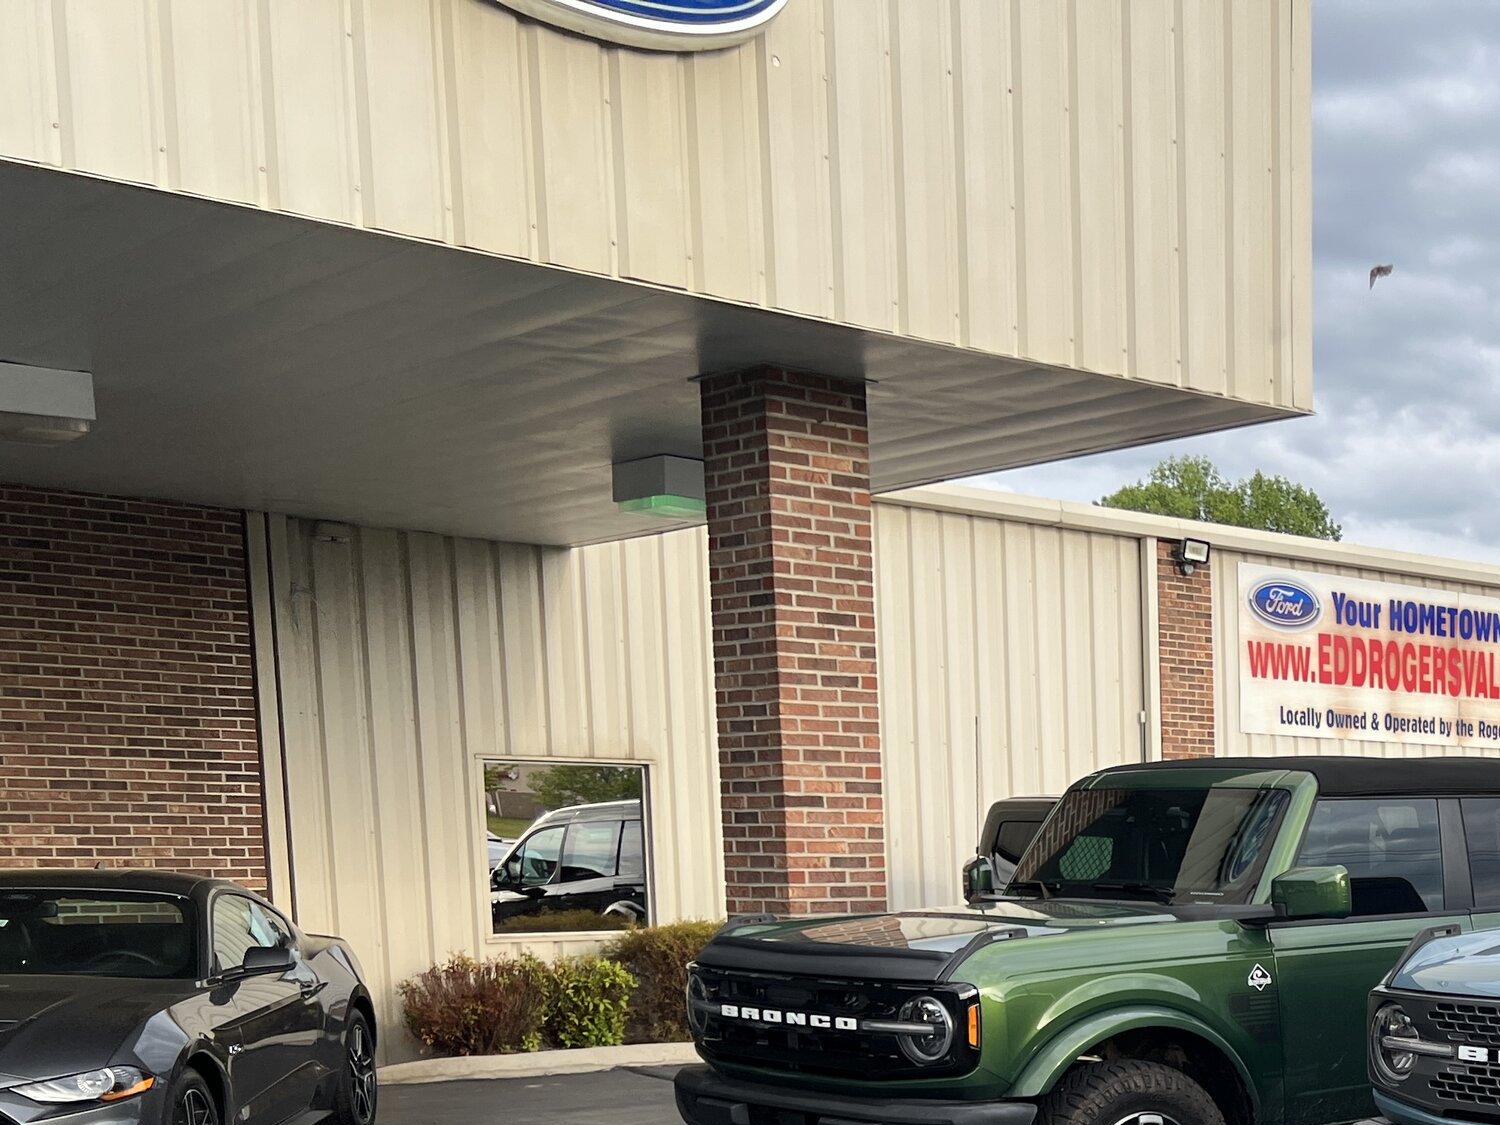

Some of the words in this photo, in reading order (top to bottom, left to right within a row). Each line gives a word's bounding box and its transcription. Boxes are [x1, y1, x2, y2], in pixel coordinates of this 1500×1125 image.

[1266, 587, 1304, 617] Ford
[1331, 591, 1381, 629] Your
[1280, 706, 1322, 729] Locally
[1326, 709, 1367, 730] Owned
[1371, 712, 1380, 731] &
[1384, 713, 1436, 735] Operated
[1439, 717, 1452, 737] by
[1456, 719, 1474, 737] the
[721, 1004, 857, 1030] BRONCO
